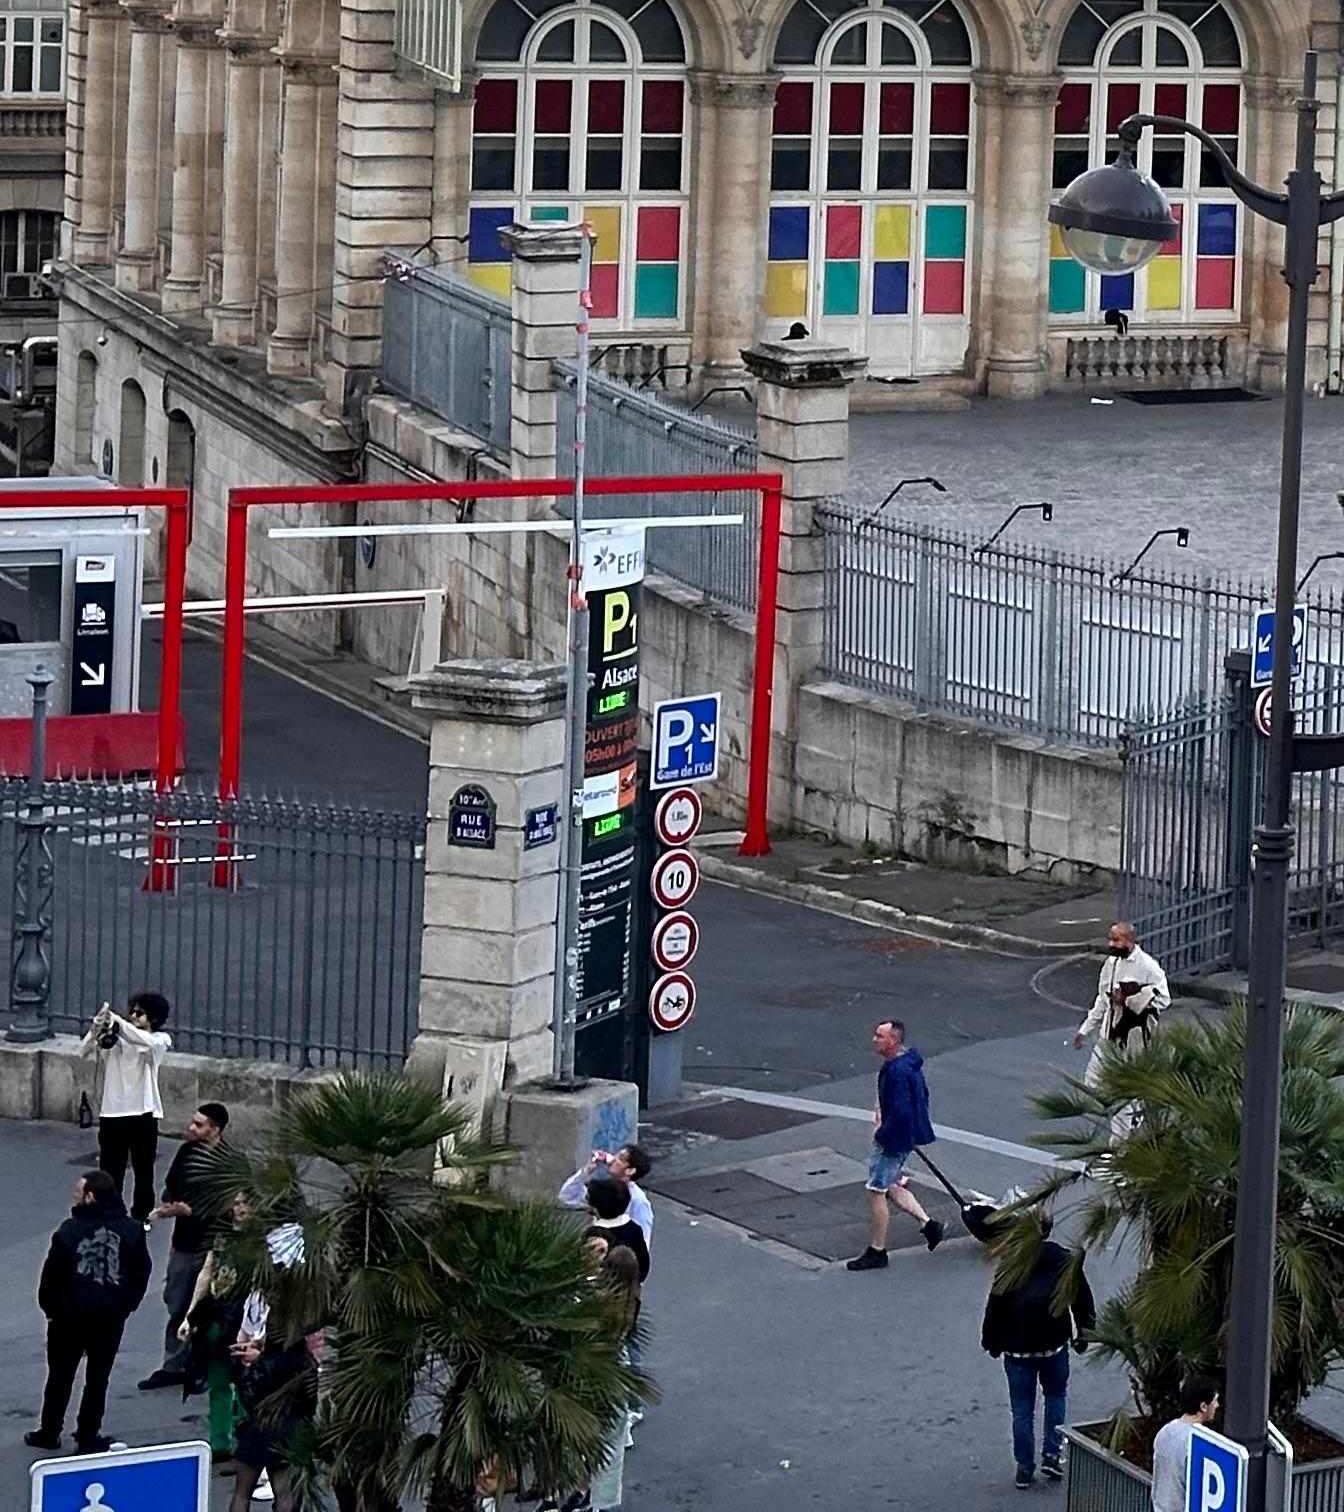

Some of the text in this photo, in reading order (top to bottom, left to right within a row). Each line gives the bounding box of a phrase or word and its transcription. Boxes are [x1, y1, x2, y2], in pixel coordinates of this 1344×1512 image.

[681, 765, 692, 777] de
[668, 870, 685, 890] 10
[1201, 1457, 1225, 1512] P
